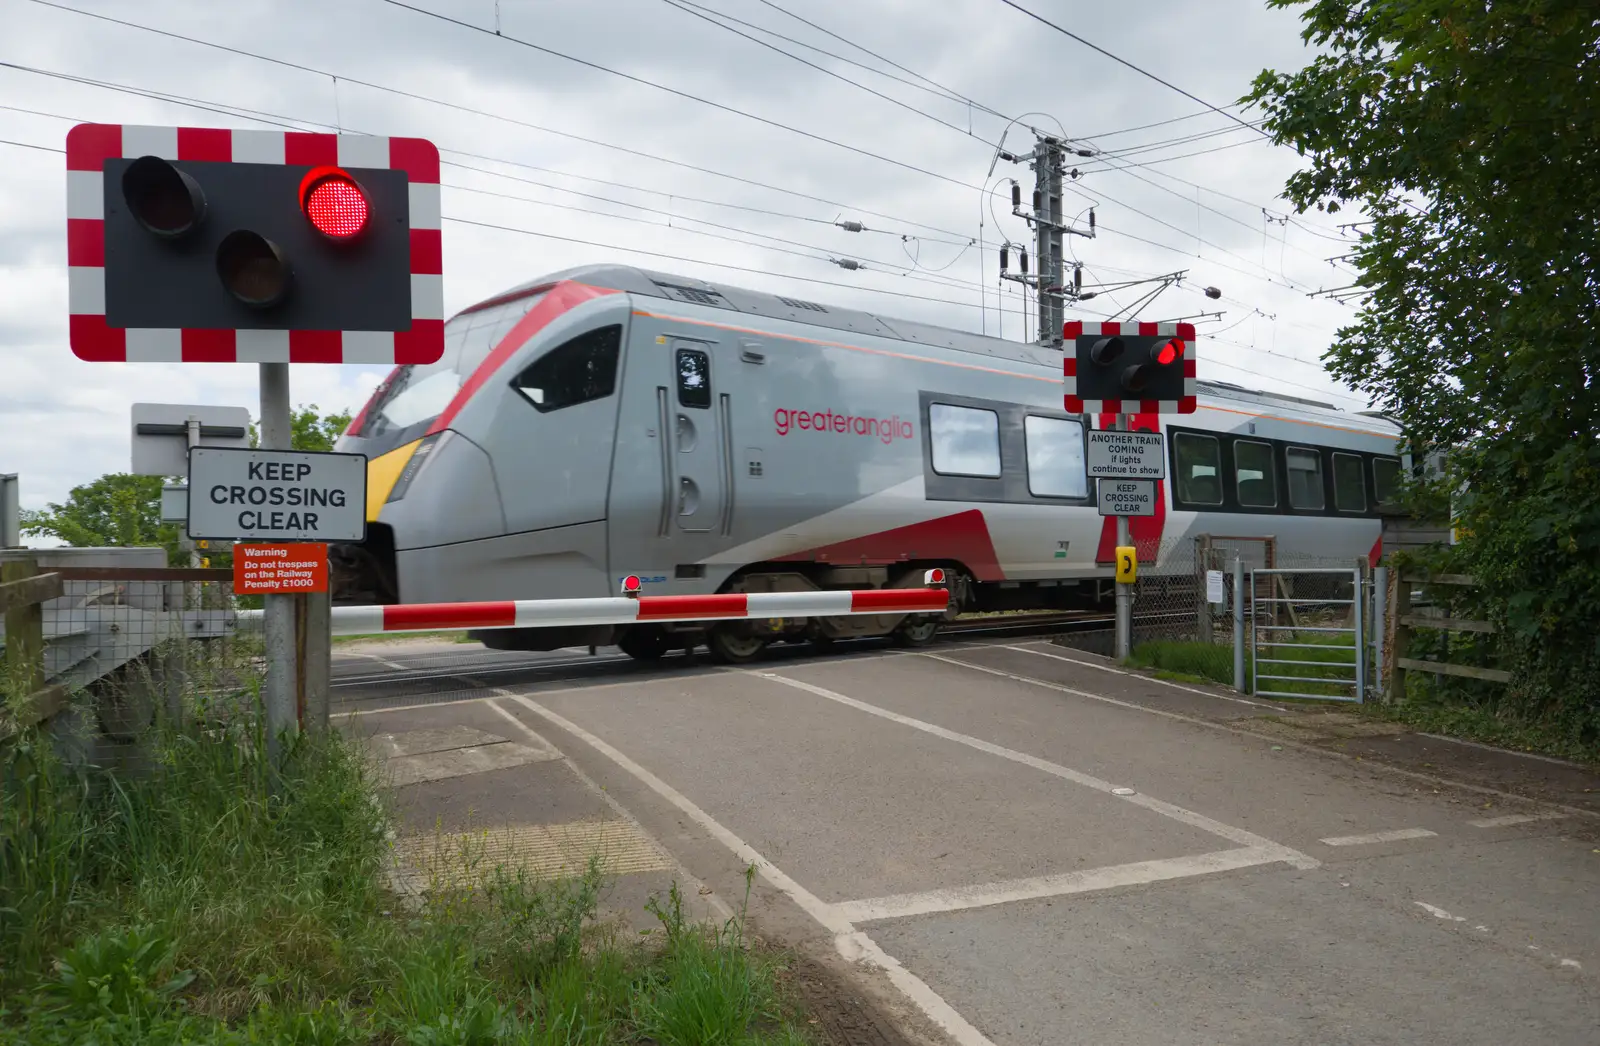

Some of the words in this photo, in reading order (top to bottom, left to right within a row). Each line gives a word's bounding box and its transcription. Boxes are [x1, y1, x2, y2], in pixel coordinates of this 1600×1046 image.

[774, 407, 913, 445] greateranglia
[1091, 434, 1133, 444] ANOTHER
[1135, 436, 1160, 445] TRAIN
[1108, 445, 1144, 454] COMING
[1111, 455, 1117, 463] if
[1119, 455, 1141, 464] lights
[248, 462, 311, 481] KEEP
[1092, 465, 1127, 473] continue
[1139, 466, 1160, 474] show
[1116, 484, 1137, 492] KEEP
[210, 485, 346, 507] CROSSING
[1105, 493, 1149, 503] CROSSING
[1114, 503, 1141, 512] CLEAR
[238, 511, 319, 531] CLEAR
[244, 548, 287, 557] Warning
[244, 561, 258, 569] Do
[278, 560, 318, 569] trespass
[259, 570, 275, 578] the
[277, 570, 313, 578] Railway
[244, 580, 280, 589] Penalty
[282, 579, 314, 587] £1000
